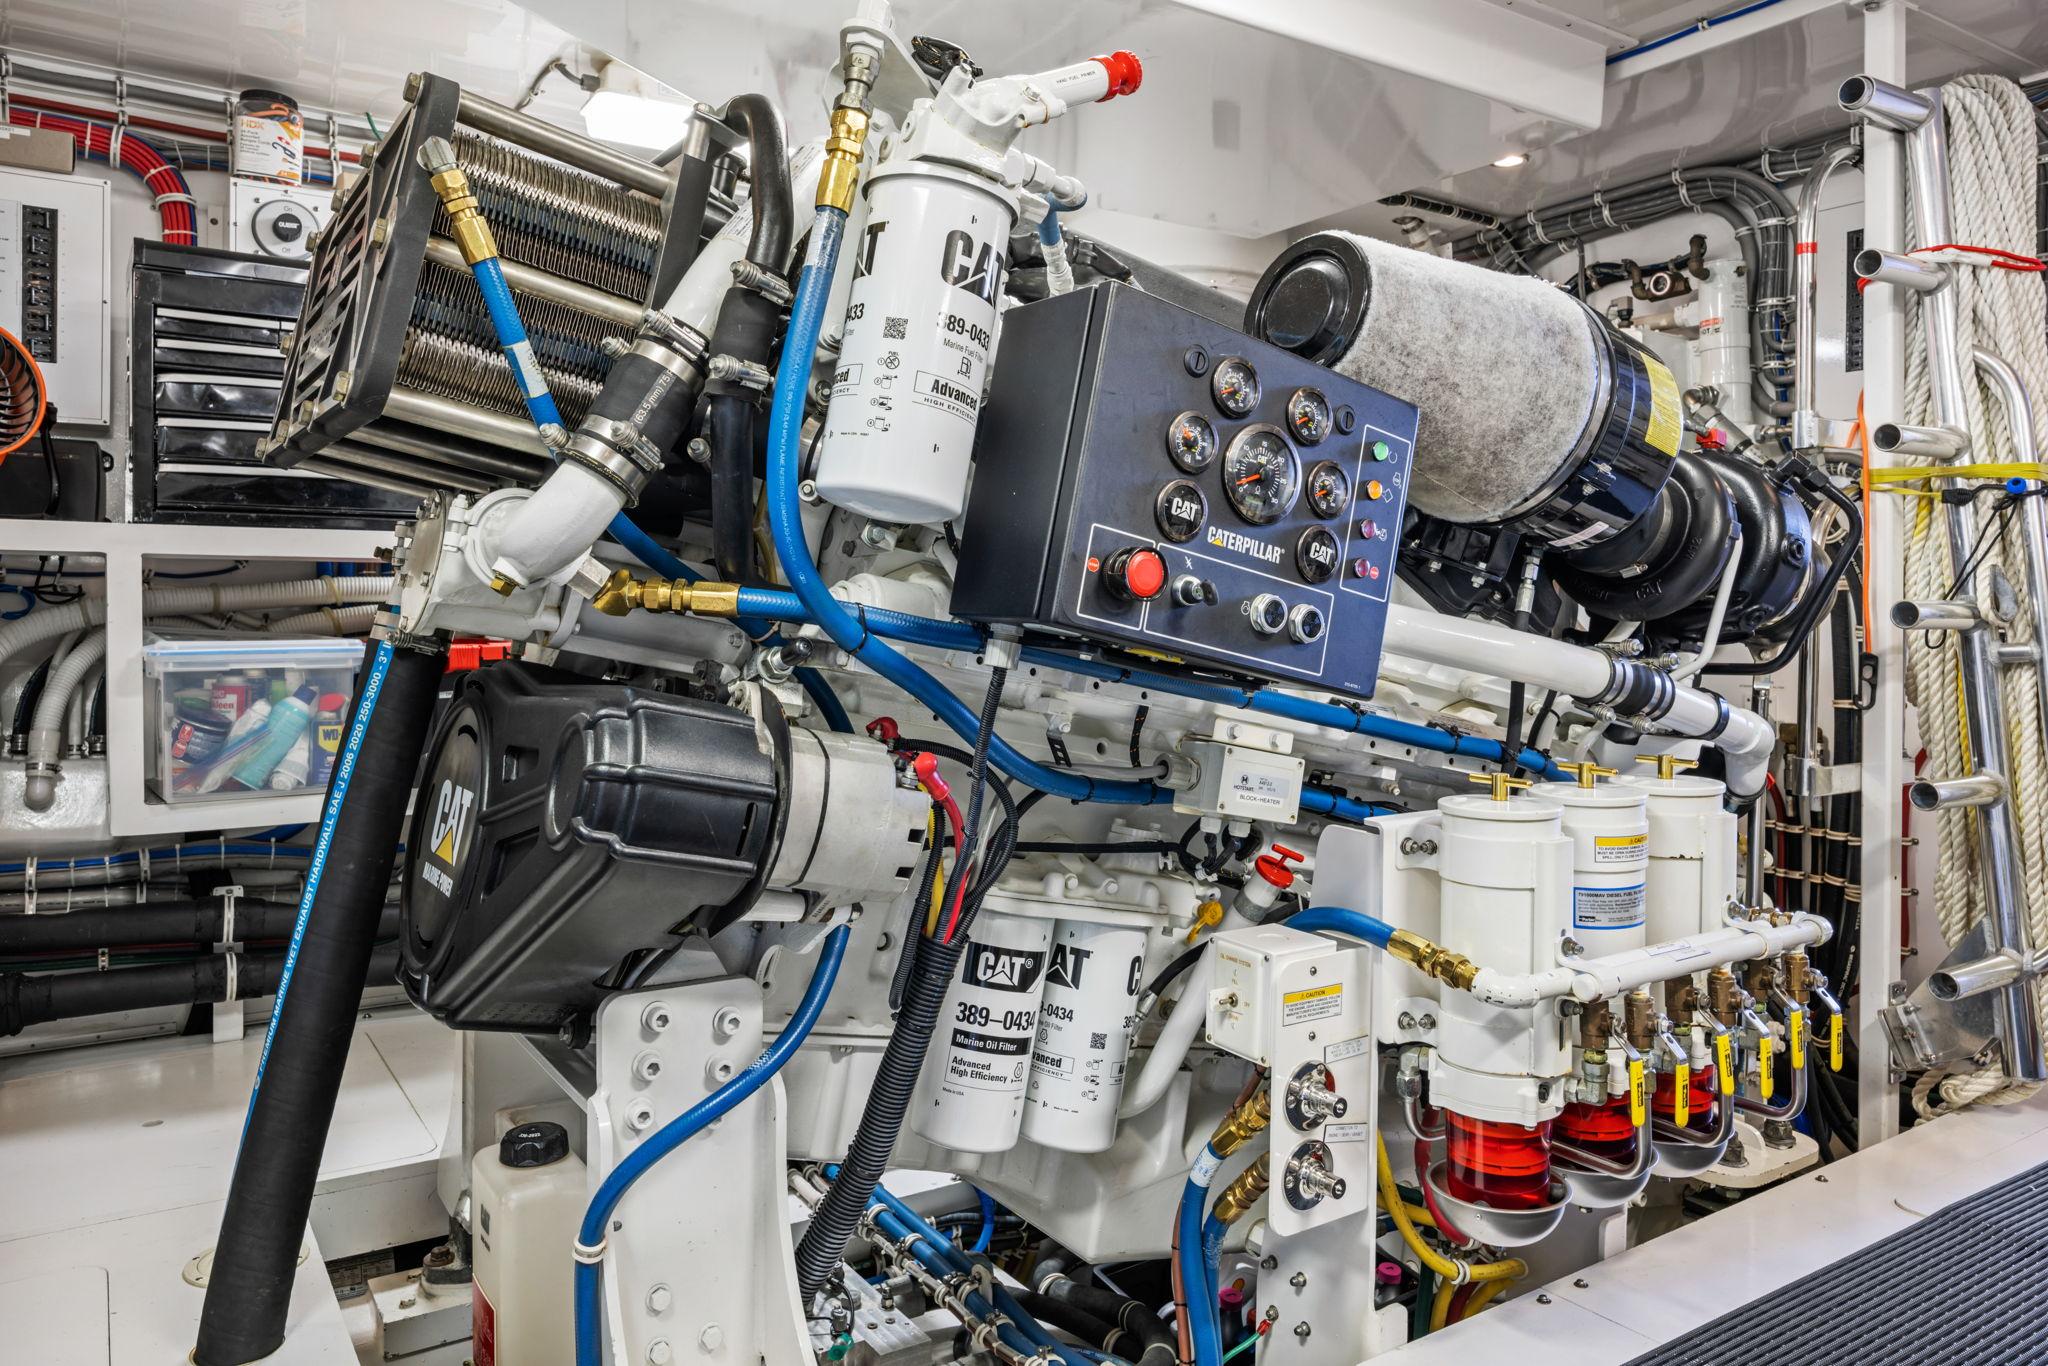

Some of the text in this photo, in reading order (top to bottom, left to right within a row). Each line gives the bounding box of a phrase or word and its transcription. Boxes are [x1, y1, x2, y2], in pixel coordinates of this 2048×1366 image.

[240, 119, 265, 130] HDX
[283, 205, 293, 213] On
[941, 229, 1005, 310] CAT
[943, 337, 964, 353] Marine
[649, 385, 664, 404] mm)
[659, 374, 671, 386] 75
[923, 396, 945, 408] HIGH
[931, 378, 978, 411] Advanced
[1171, 497, 1198, 522] CAT
[1207, 525, 1282, 564] CATERPILLAR
[1309, 542, 1334, 564] CAT
[358, 672, 382, 722] 250-3000
[322, 728, 341, 741] WD-
[349, 724, 364, 750] 2020
[340, 751, 355, 779] 2006
[338, 780, 346, 792] J
[329, 792, 344, 815] SAE
[1239, 794, 1281, 805] BLOCK-HEATER
[430, 779, 474, 867] CAT
[310, 817, 334, 884] HARDWALL
[421, 861, 441, 889] MARINE
[294, 884, 315, 941] EXHAUST
[286, 942, 298, 969] WET
[1045, 943, 1091, 990] AT
[977, 951, 1026, 987] CAT
[274, 970, 290, 1018] MARINE
[1305, 989, 1326, 999] CAUTION
[258, 1017, 278, 1073] PREMIUM
[955, 1033, 1018, 1052] Marine Oil Filter
[951, 1055, 991, 1071] Advanced
[1032, 1050, 1063, 1068] vanced
[950, 1066, 1008, 1084] High Efficiency
